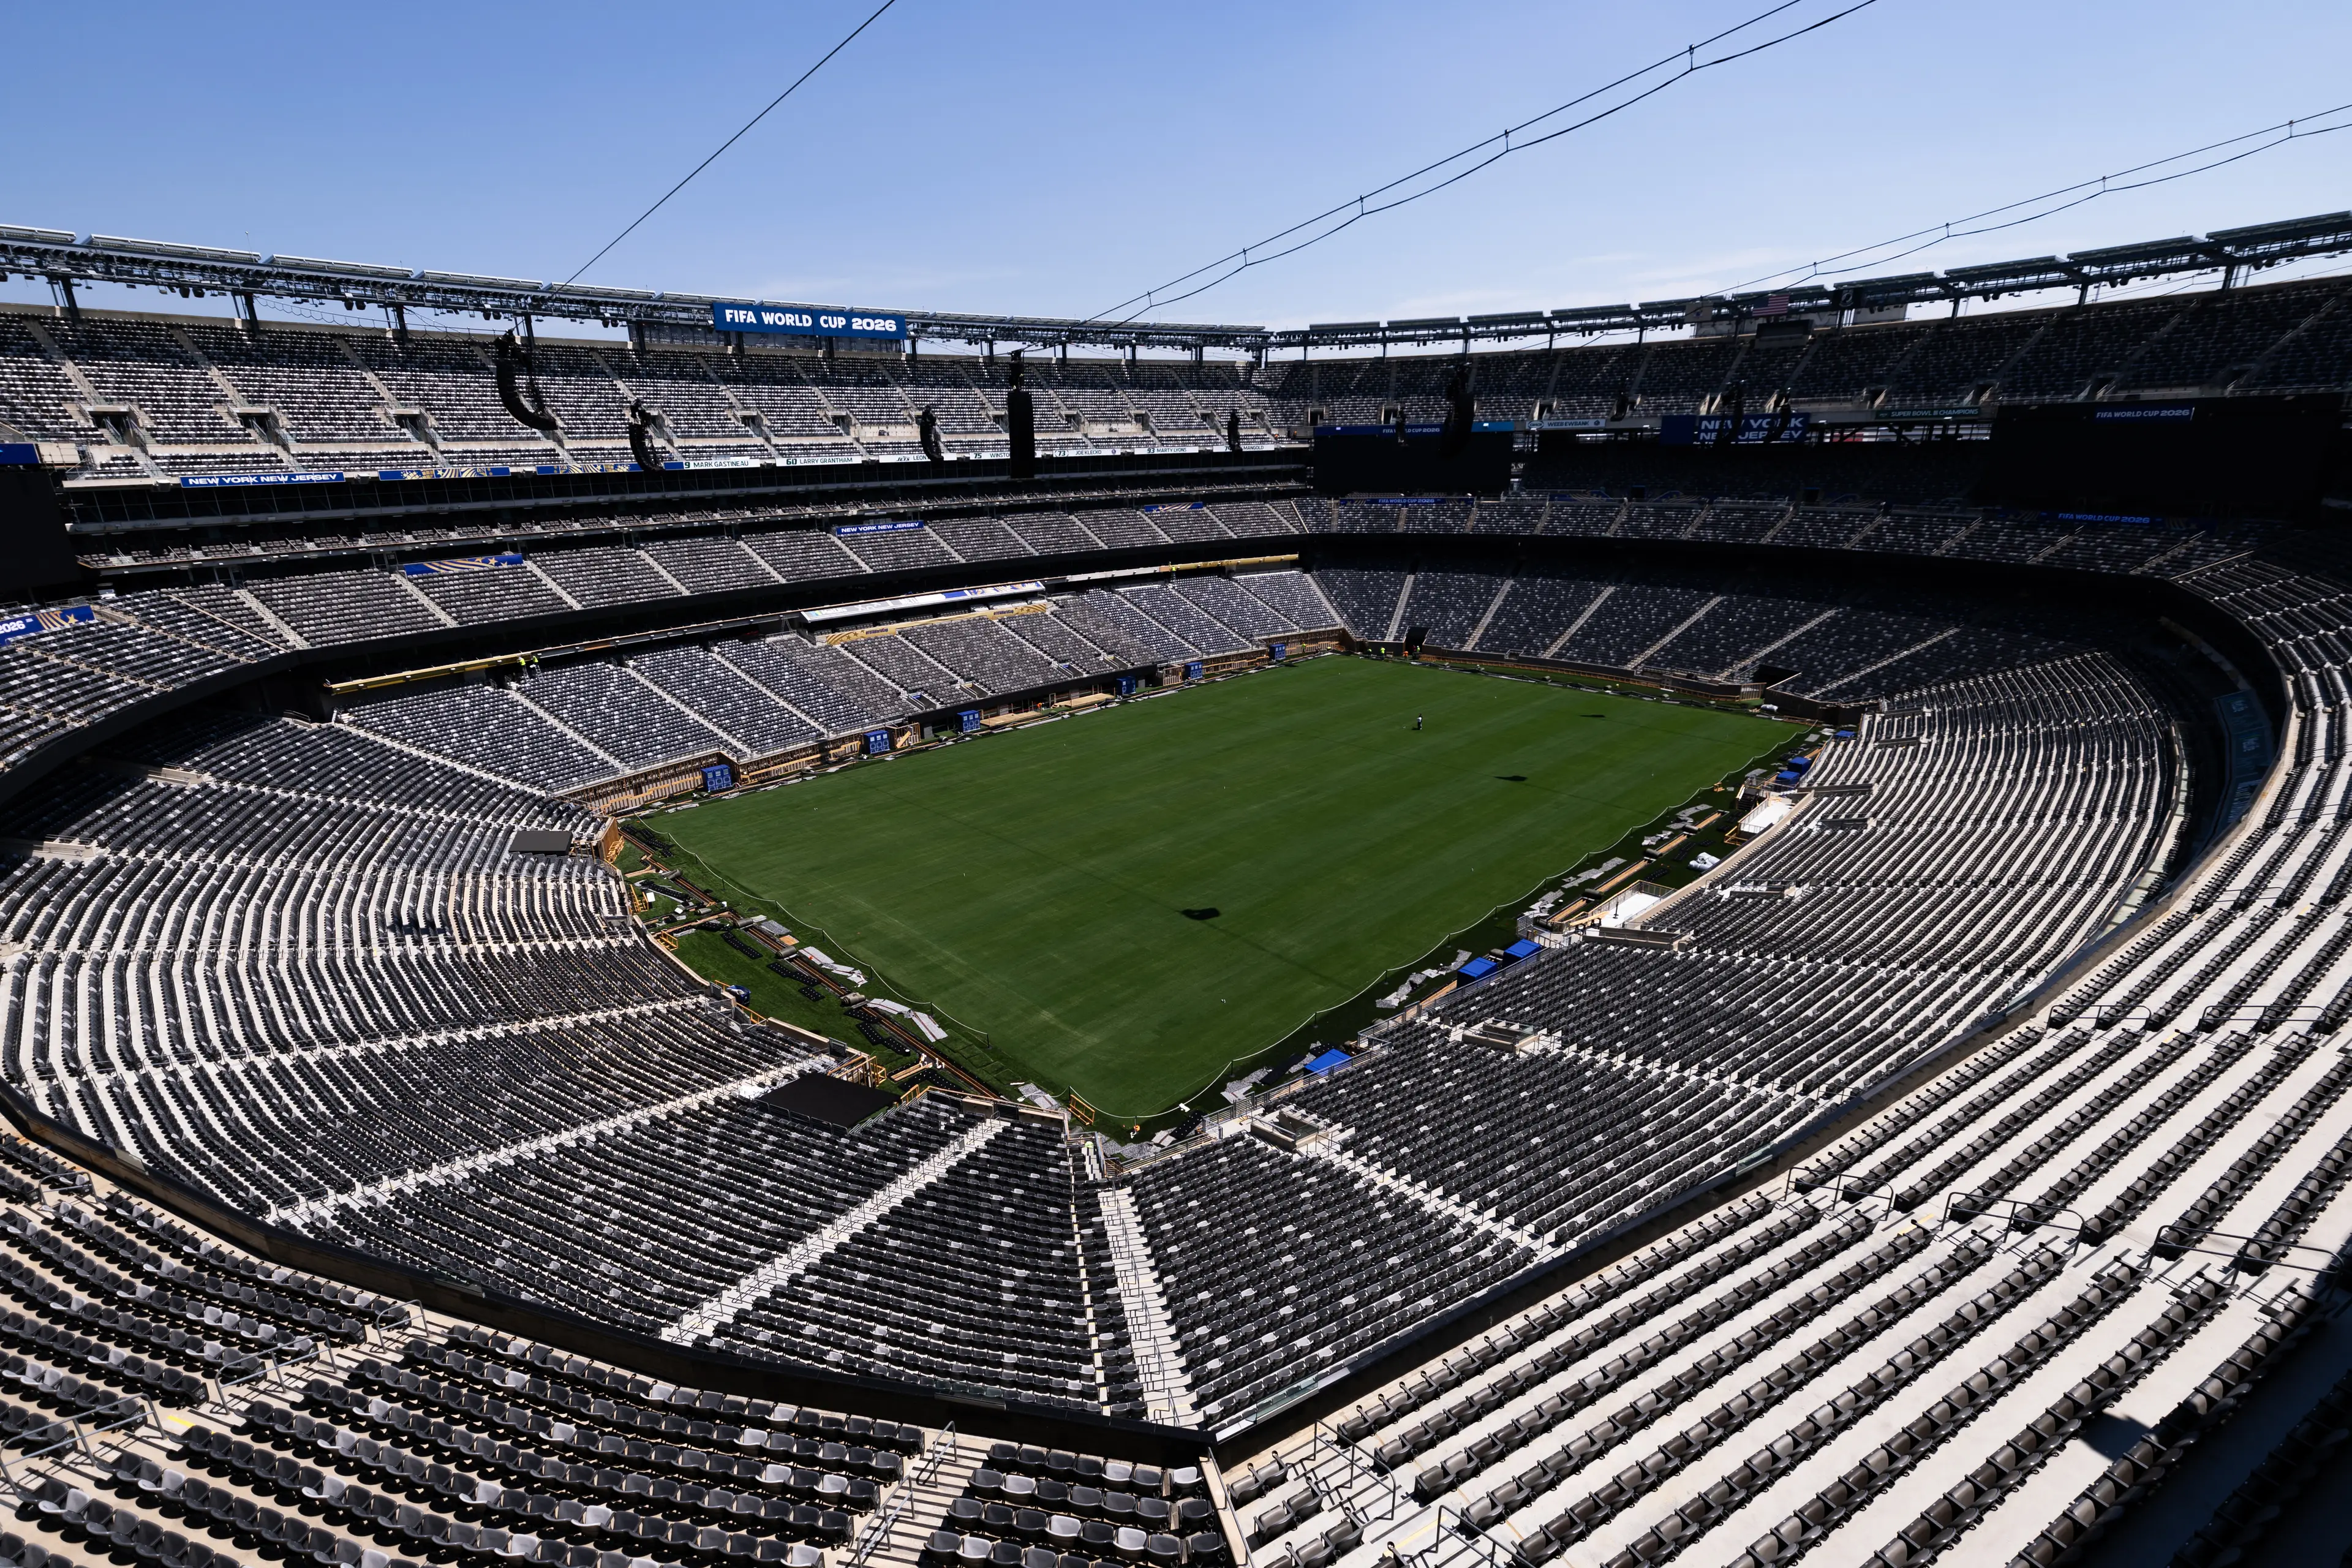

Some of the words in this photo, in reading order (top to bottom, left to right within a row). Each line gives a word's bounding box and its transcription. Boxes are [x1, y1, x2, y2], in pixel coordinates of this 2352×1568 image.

[725, 309, 756, 324] FIFA
[761, 311, 812, 327] WORLD
[820, 315, 846, 329] CUP
[851, 318, 897, 331] 2026
[1738, 430, 1803, 440] JEREY
